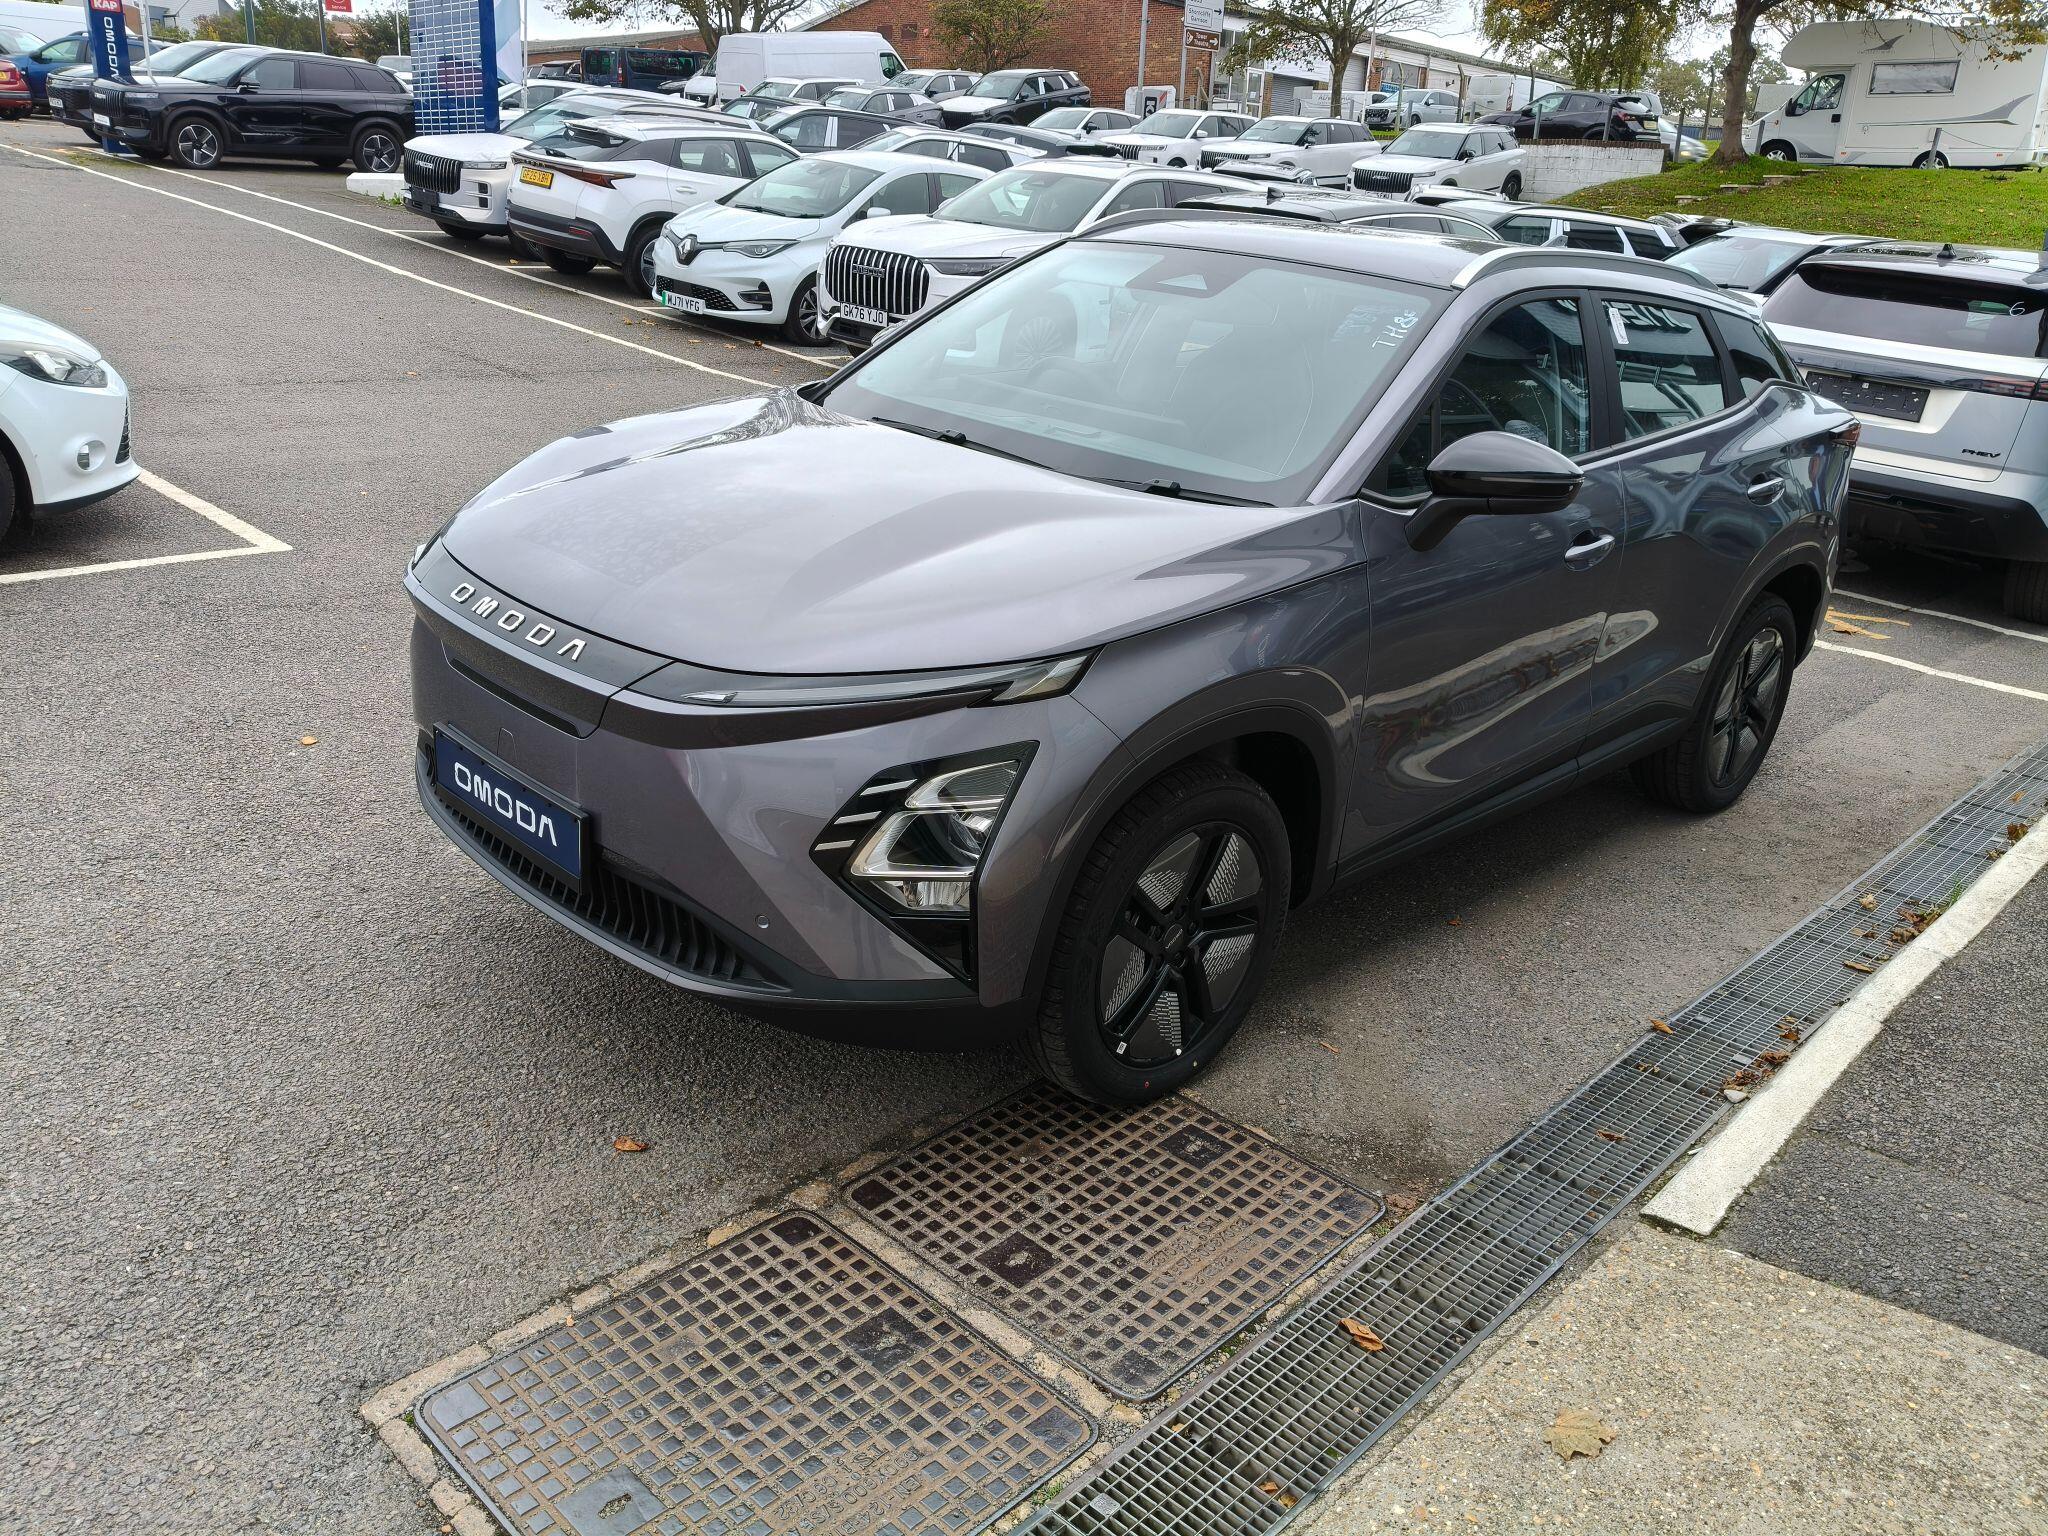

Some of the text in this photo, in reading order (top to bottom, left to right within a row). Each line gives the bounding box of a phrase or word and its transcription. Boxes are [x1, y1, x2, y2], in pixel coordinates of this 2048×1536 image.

[94, 0, 118, 9] KAP
[103, 16, 120, 78] OMODA
[684, 298, 700, 312] YFG
[843, 304, 865, 320] GK76
[2009, 300, 2026, 317] 6
[1961, 448, 2001, 459] PHEV
[450, 582, 588, 662] OMODA
[454, 761, 558, 848] OMODA
